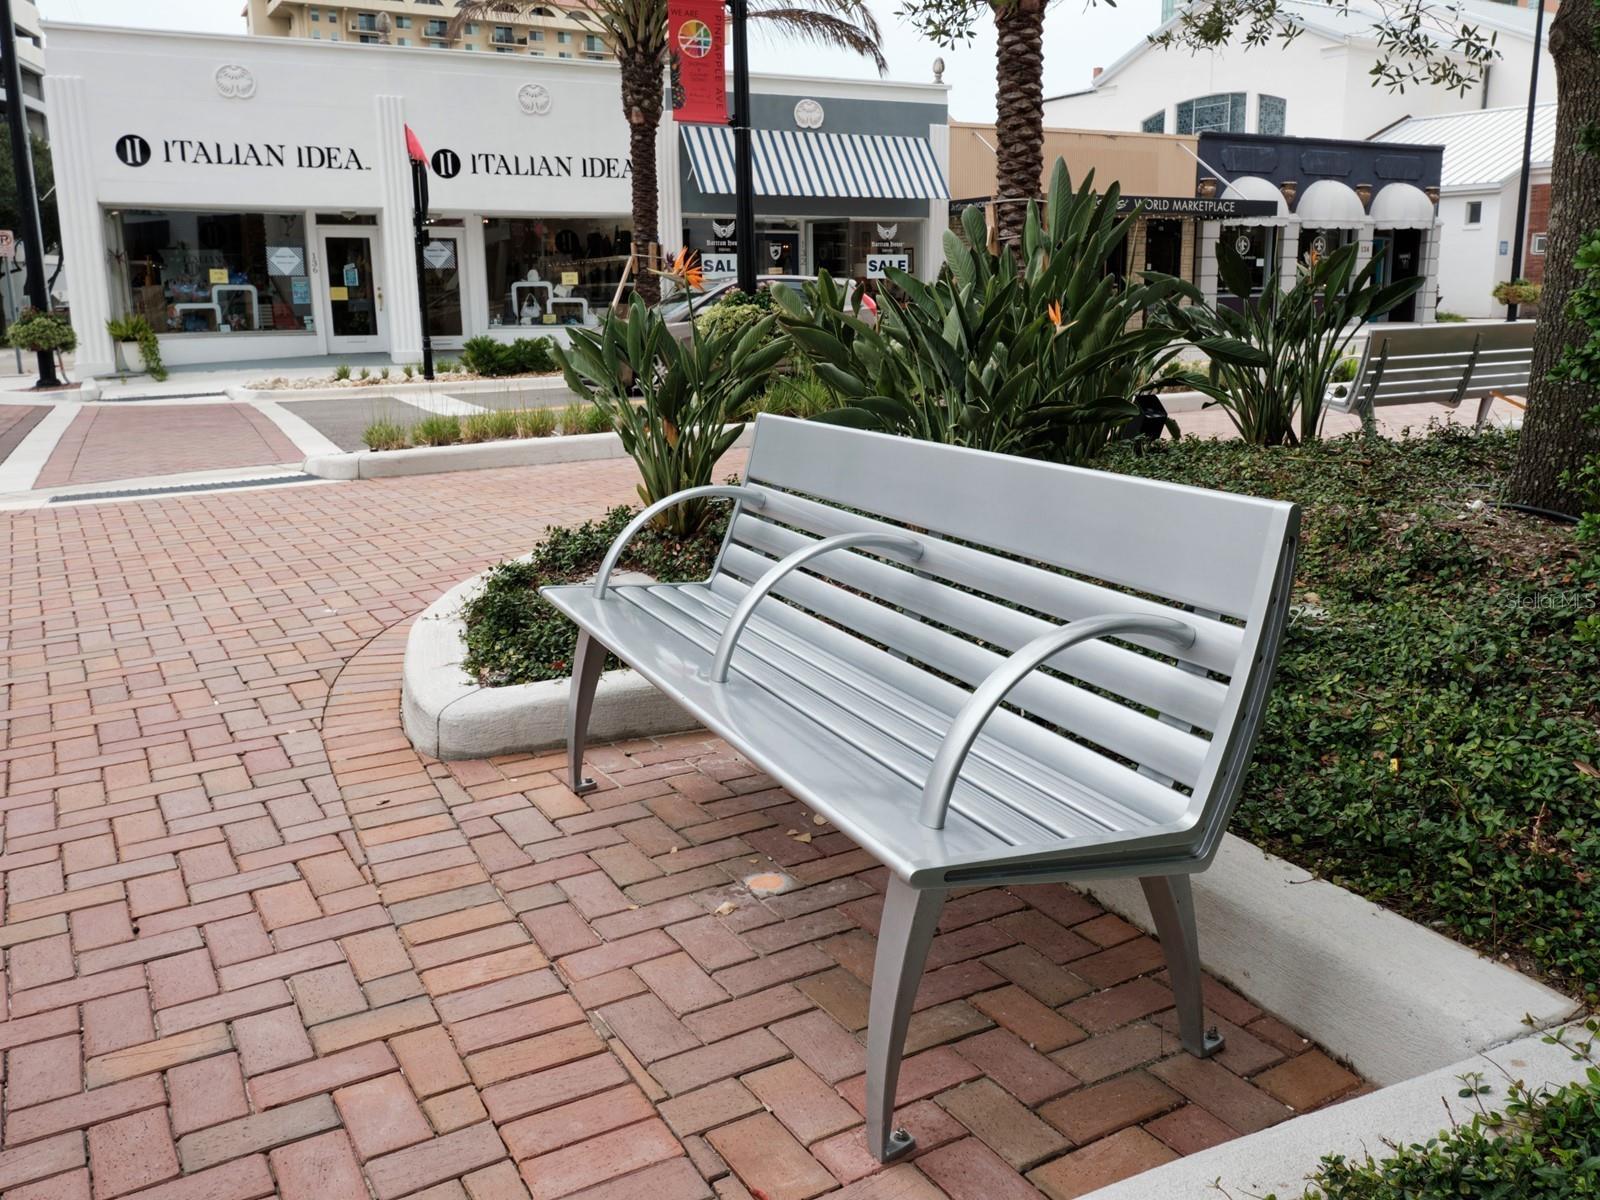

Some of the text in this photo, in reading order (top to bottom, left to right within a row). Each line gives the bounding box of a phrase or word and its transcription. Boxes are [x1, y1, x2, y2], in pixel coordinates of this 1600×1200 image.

[714, 15, 724, 112] PINEAPPLE AVE
[163, 139, 286, 167] ITALIAN
[471, 153, 573, 177] ITALIAN
[581, 157, 632, 179] IDEA
[1134, 199, 1170, 211] WORLD
[1172, 200, 1235, 213] MARKETPLACE
[703, 260, 736, 273] SAL
